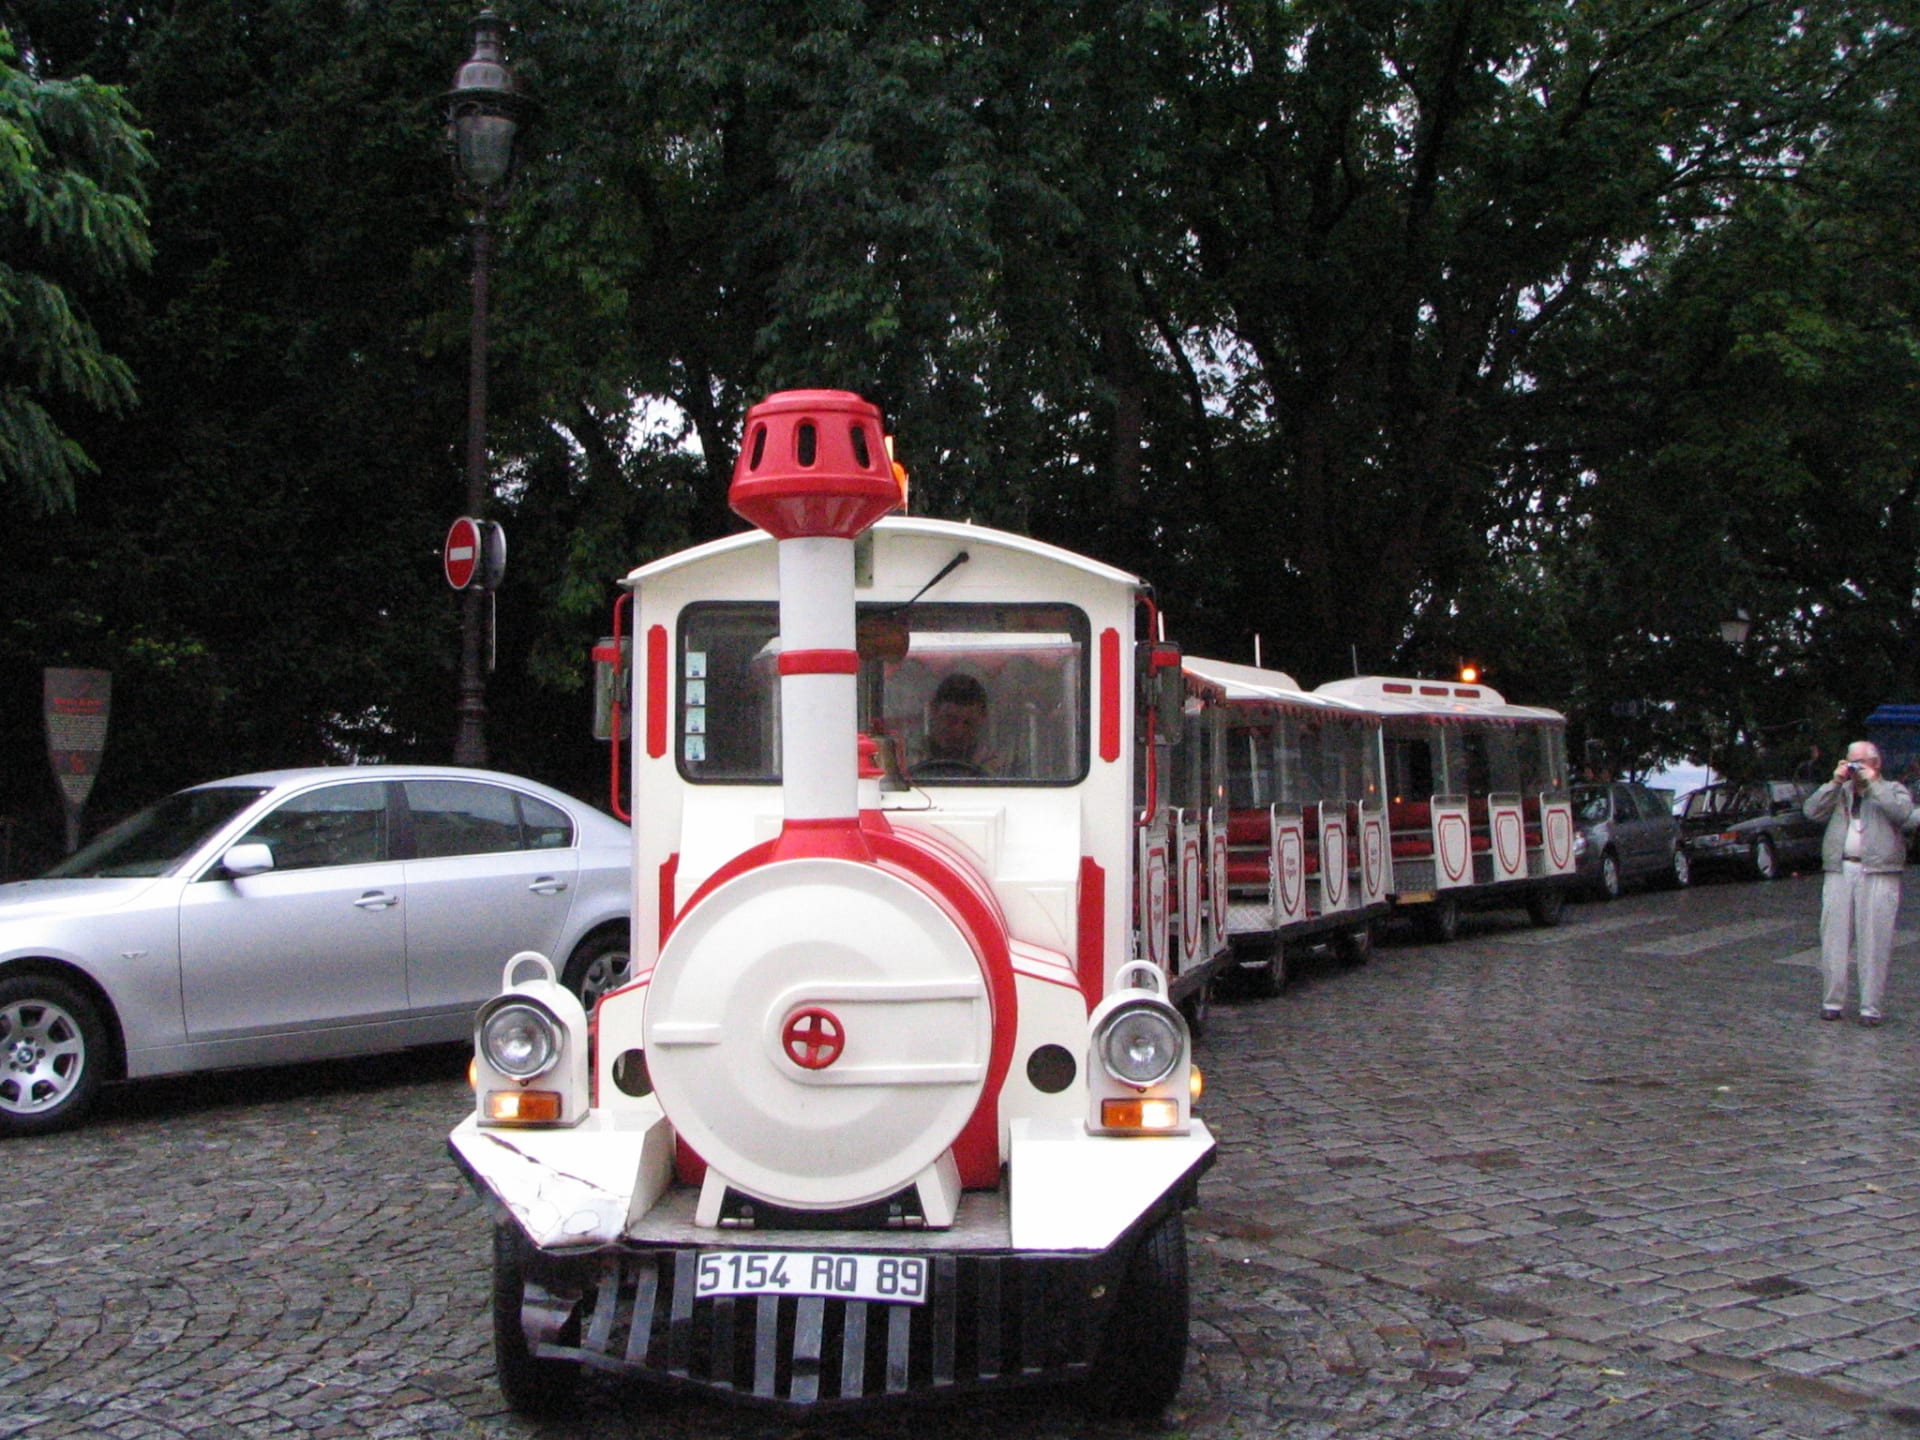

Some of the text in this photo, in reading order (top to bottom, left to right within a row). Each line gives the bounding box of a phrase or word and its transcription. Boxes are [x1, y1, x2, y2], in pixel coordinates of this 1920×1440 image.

[699, 1254, 922, 1296] 5154 RQ 89
